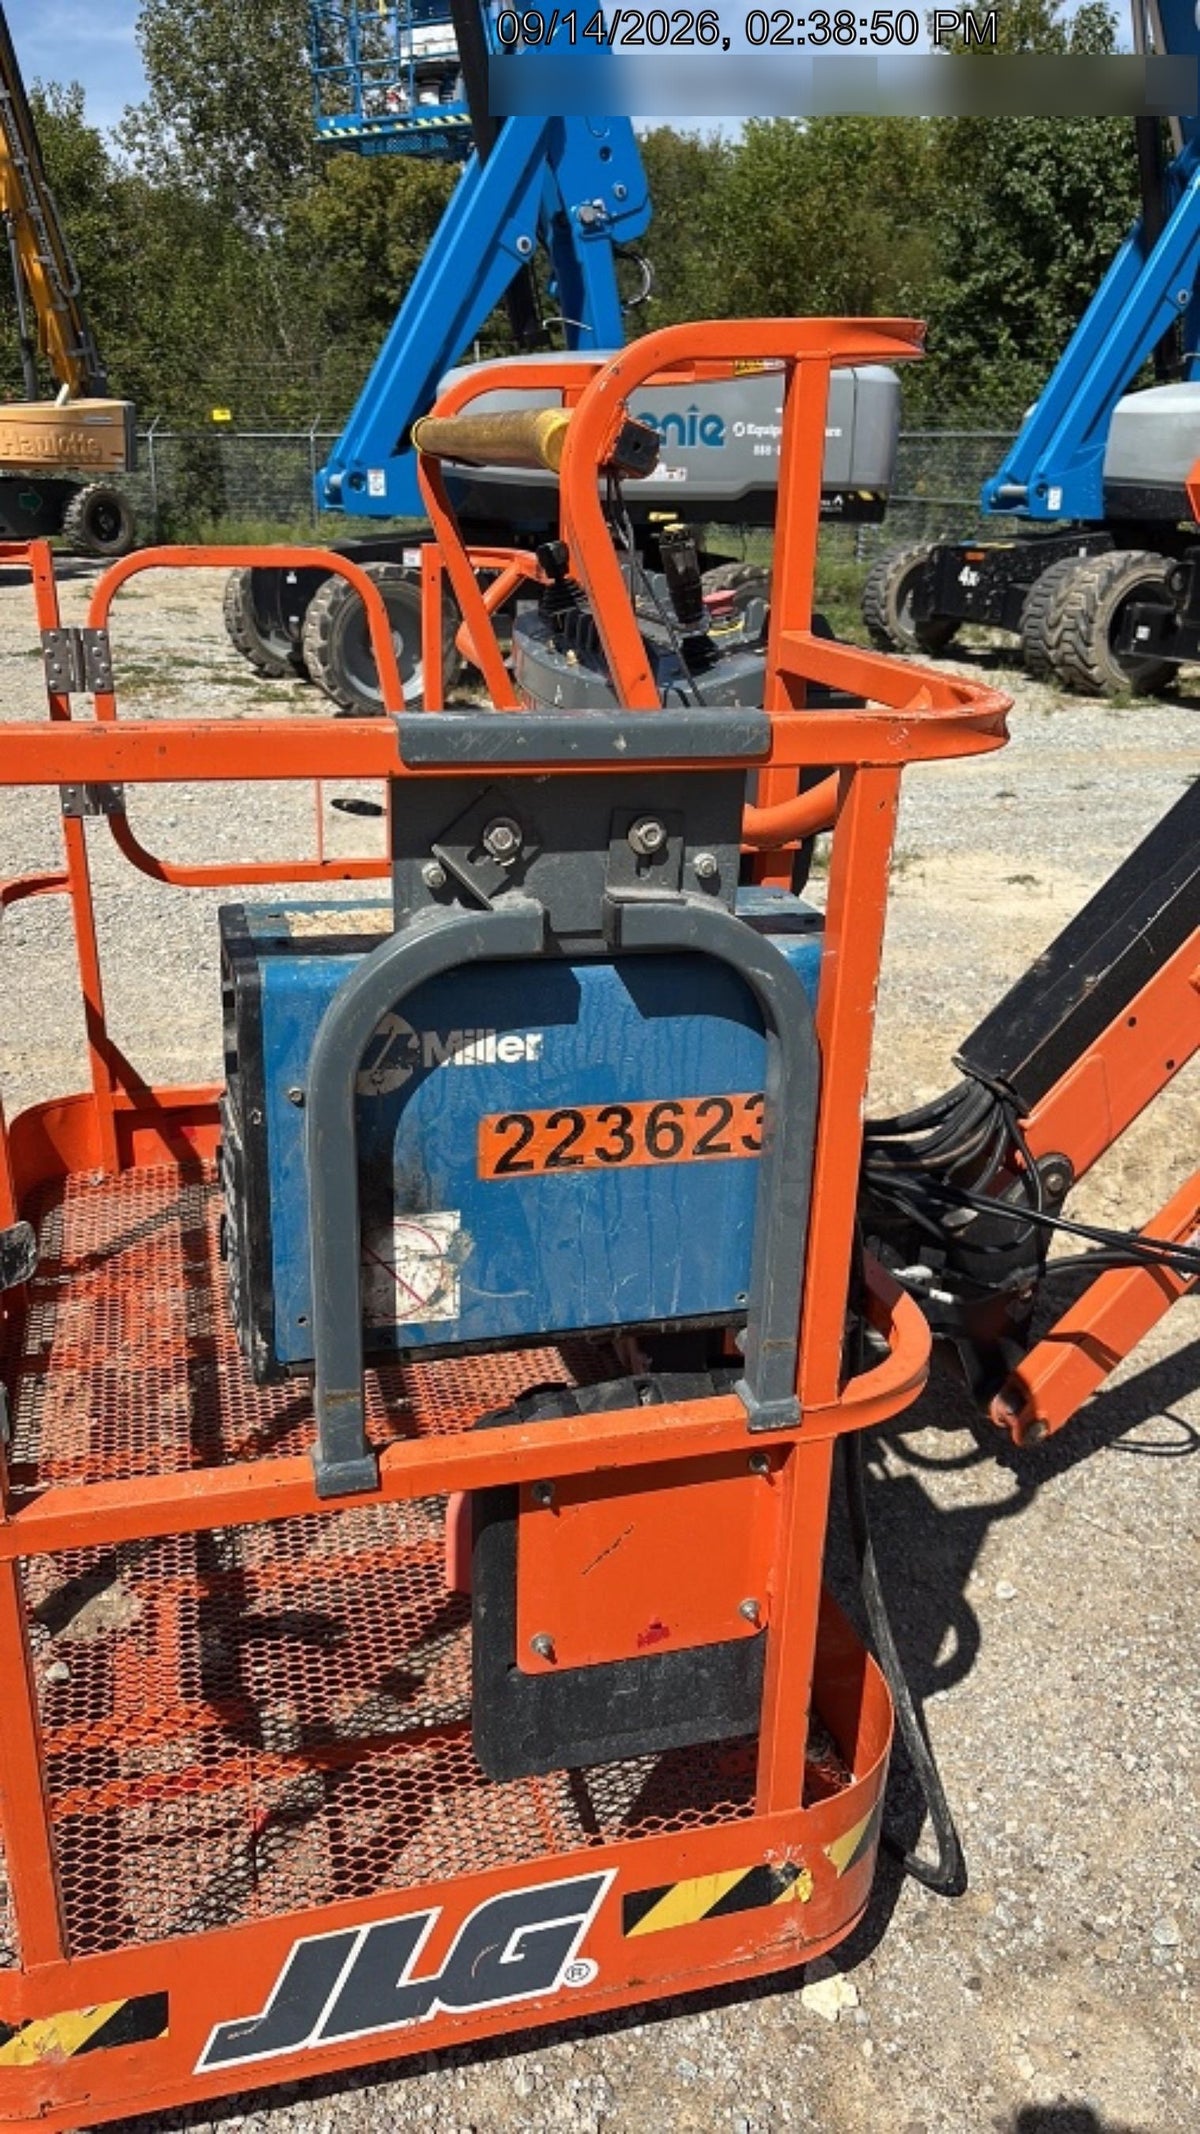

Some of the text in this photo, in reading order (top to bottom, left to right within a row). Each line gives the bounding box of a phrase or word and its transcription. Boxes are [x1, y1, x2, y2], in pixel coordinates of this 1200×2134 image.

[422, 1029, 543, 1067] Miller
[493, 1094, 764, 1174] 223623
[193, 1867, 619, 2075] JLG
